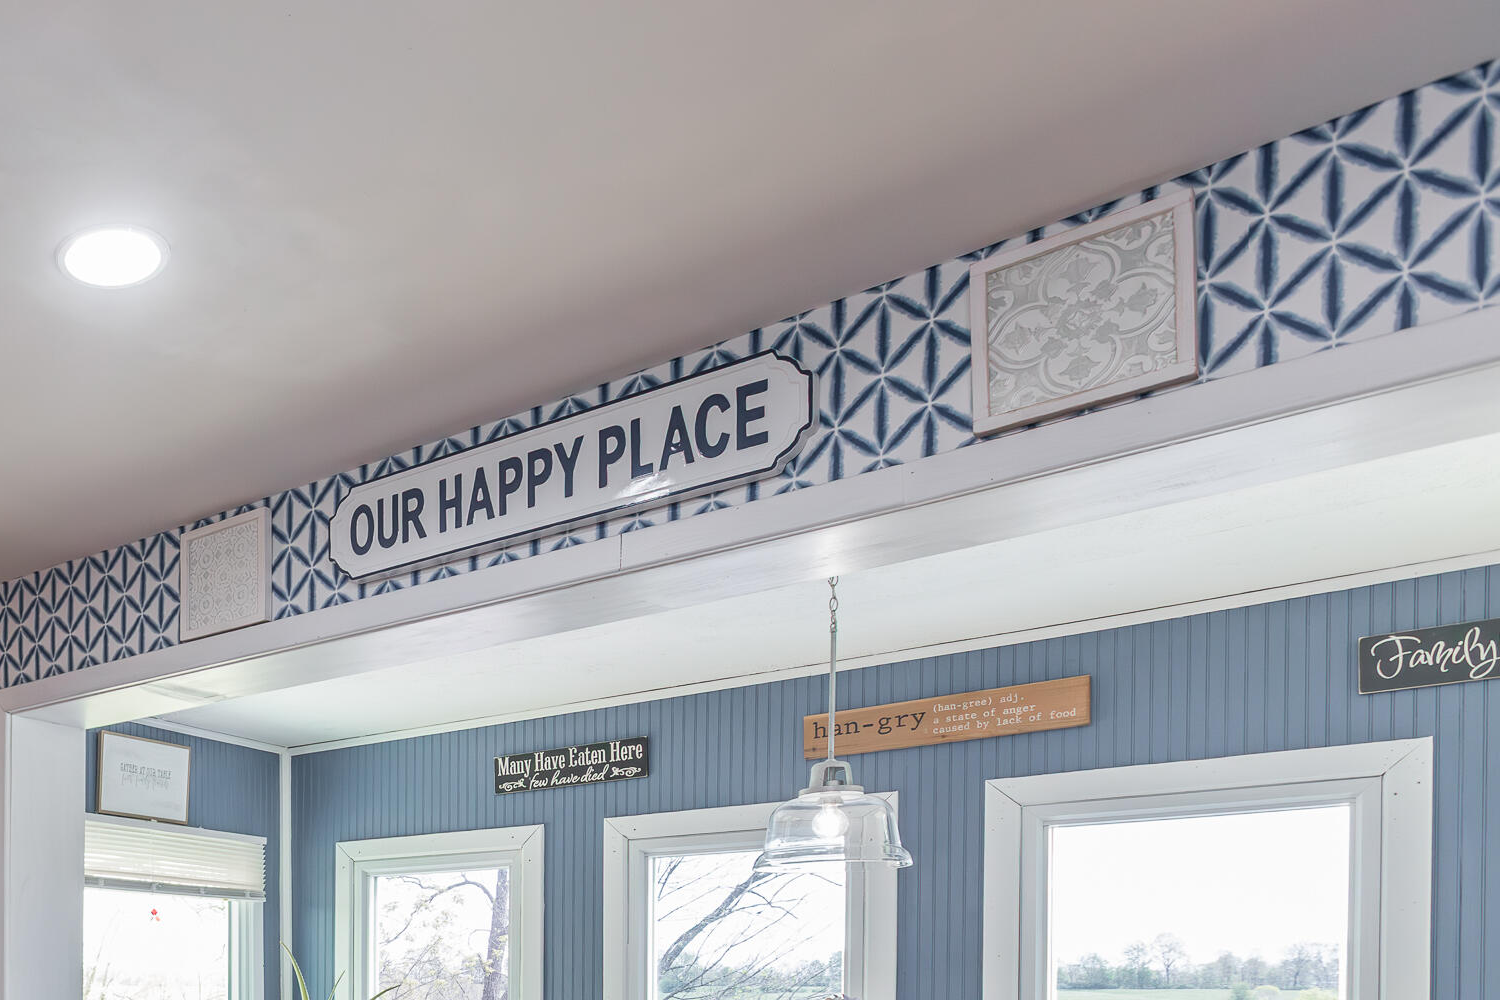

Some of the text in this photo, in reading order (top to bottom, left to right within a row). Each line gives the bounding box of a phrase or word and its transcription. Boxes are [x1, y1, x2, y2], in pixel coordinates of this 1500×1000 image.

[350, 378, 769, 556] OUR HAPPY PLACE
[1370, 626, 1500, 680] Family
[932, 692, 1025, 713] (han-gree) adj.
[945, 711, 977, 722] state
[982, 707, 997, 718] of
[1002, 703, 1037, 717] anger
[812, 711, 927, 739] han-gry
[932, 707, 1077, 735] caused by lack of food
[497, 741, 643, 778] Many Have Eaten Here
[528, 764, 609, 790] few have died
